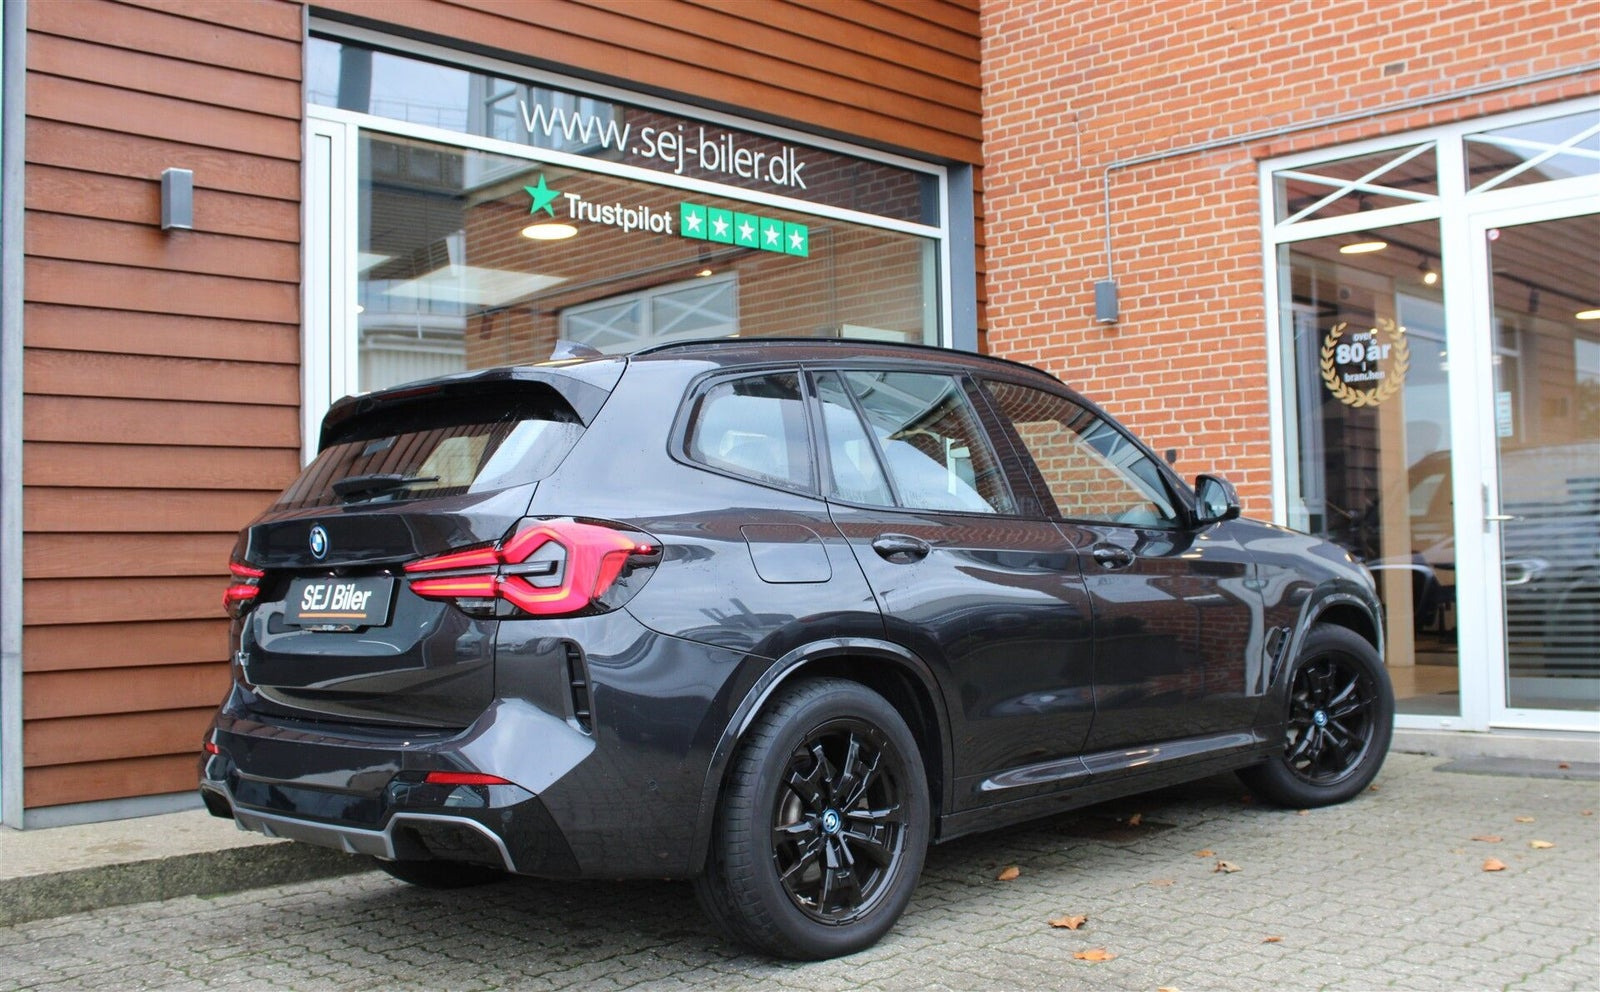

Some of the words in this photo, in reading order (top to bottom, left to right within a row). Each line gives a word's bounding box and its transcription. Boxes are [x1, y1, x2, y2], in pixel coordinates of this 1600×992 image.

[520, 100, 807, 190] www.sej-biler.dk
[563, 192, 673, 233] Trustpilot
[1352, 331, 1372, 342] over
[1336, 342, 1365, 364] 80
[1366, 339, 1391, 361] år
[301, 584, 333, 611] SEJ
[331, 583, 372, 611] Biler
